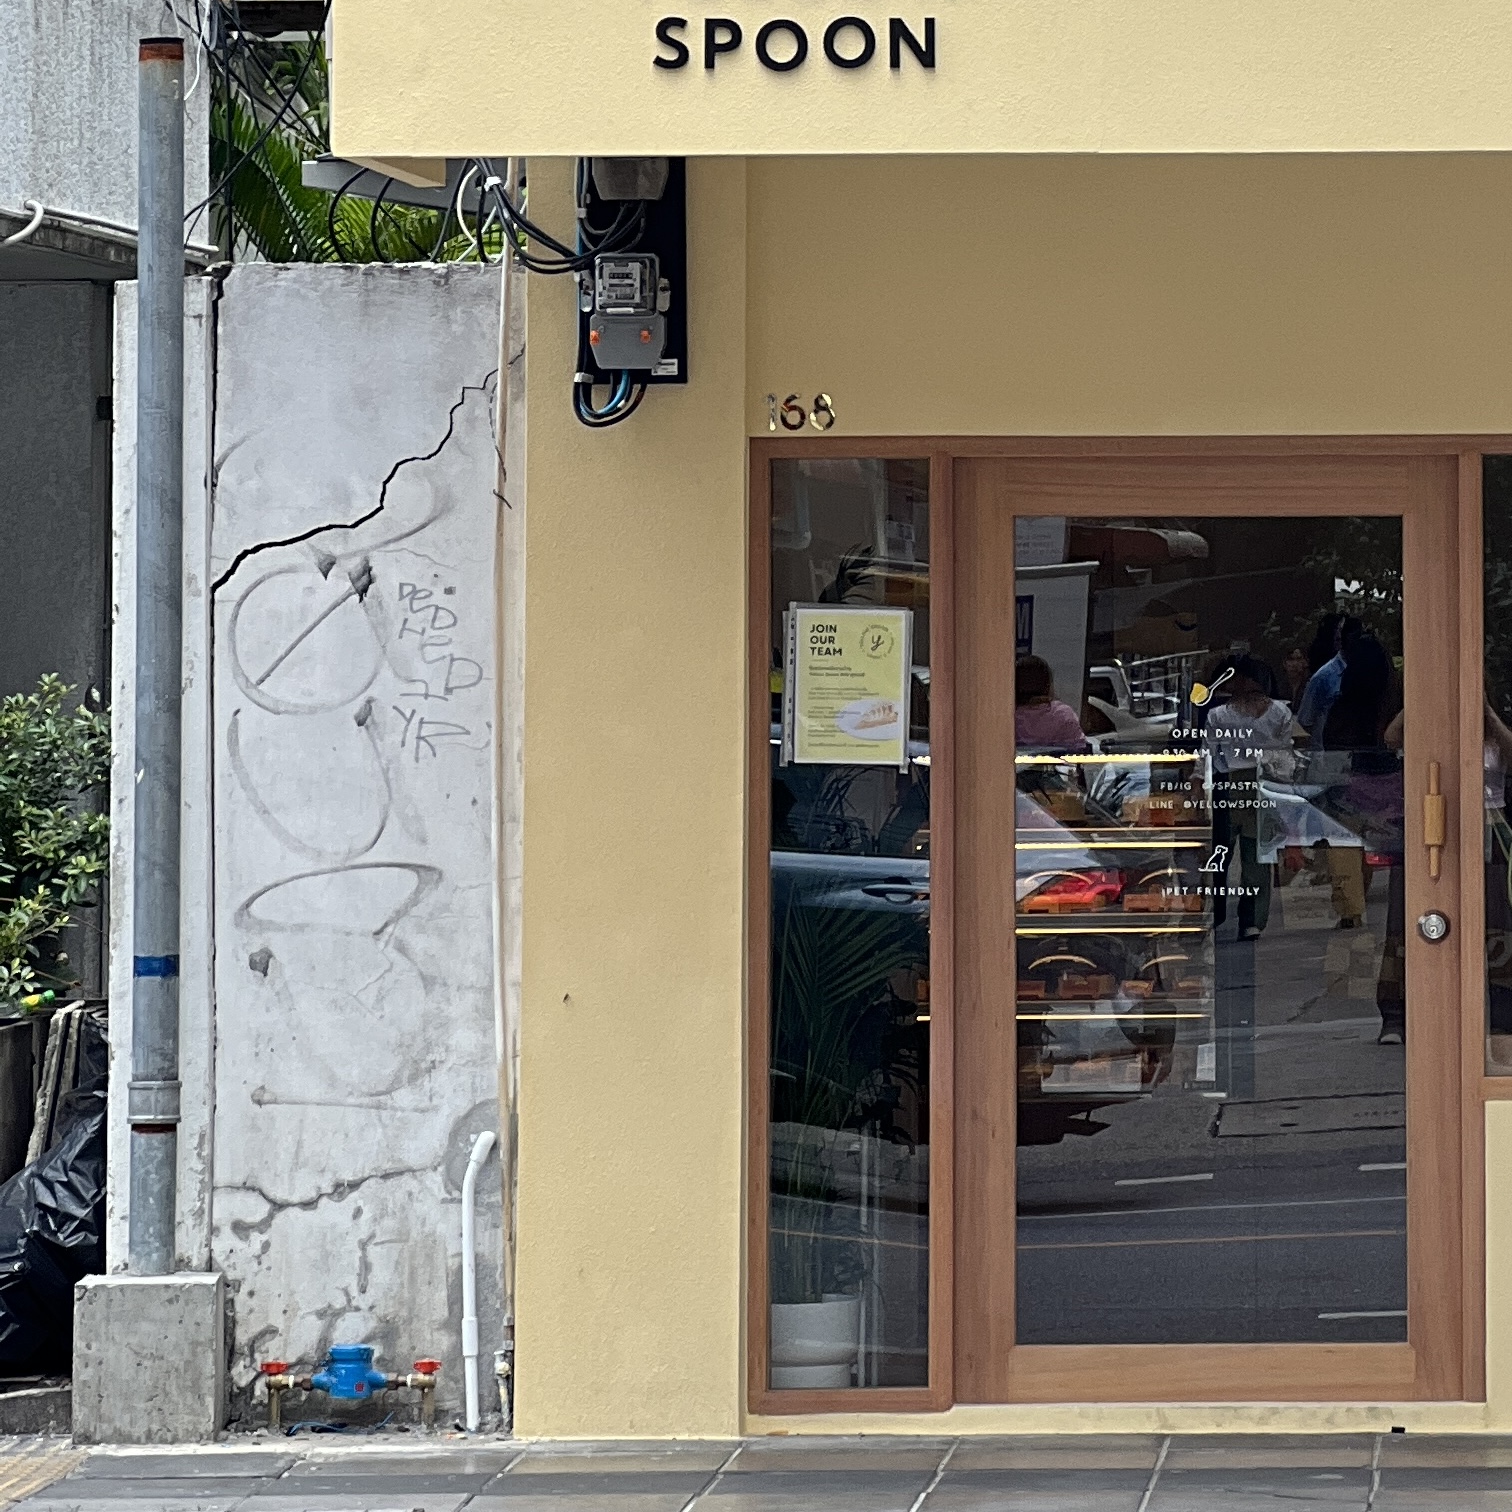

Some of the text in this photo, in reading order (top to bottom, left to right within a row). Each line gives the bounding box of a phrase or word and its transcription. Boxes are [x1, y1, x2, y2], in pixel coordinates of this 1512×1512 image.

[653, 16, 936, 72] SPOON
[809, 624, 838, 634] JOIN
[809, 635, 836, 645] OUR
[809, 646, 843, 656] TEAM
[1172, 728, 1254, 739] OPEN DAILY
[1233, 748, 1241, 758] 7
[1245, 748, 1264, 758] PM
[1149, 800, 1174, 810] LINE
[1164, 887, 1260, 896] PET FRIENDLY
